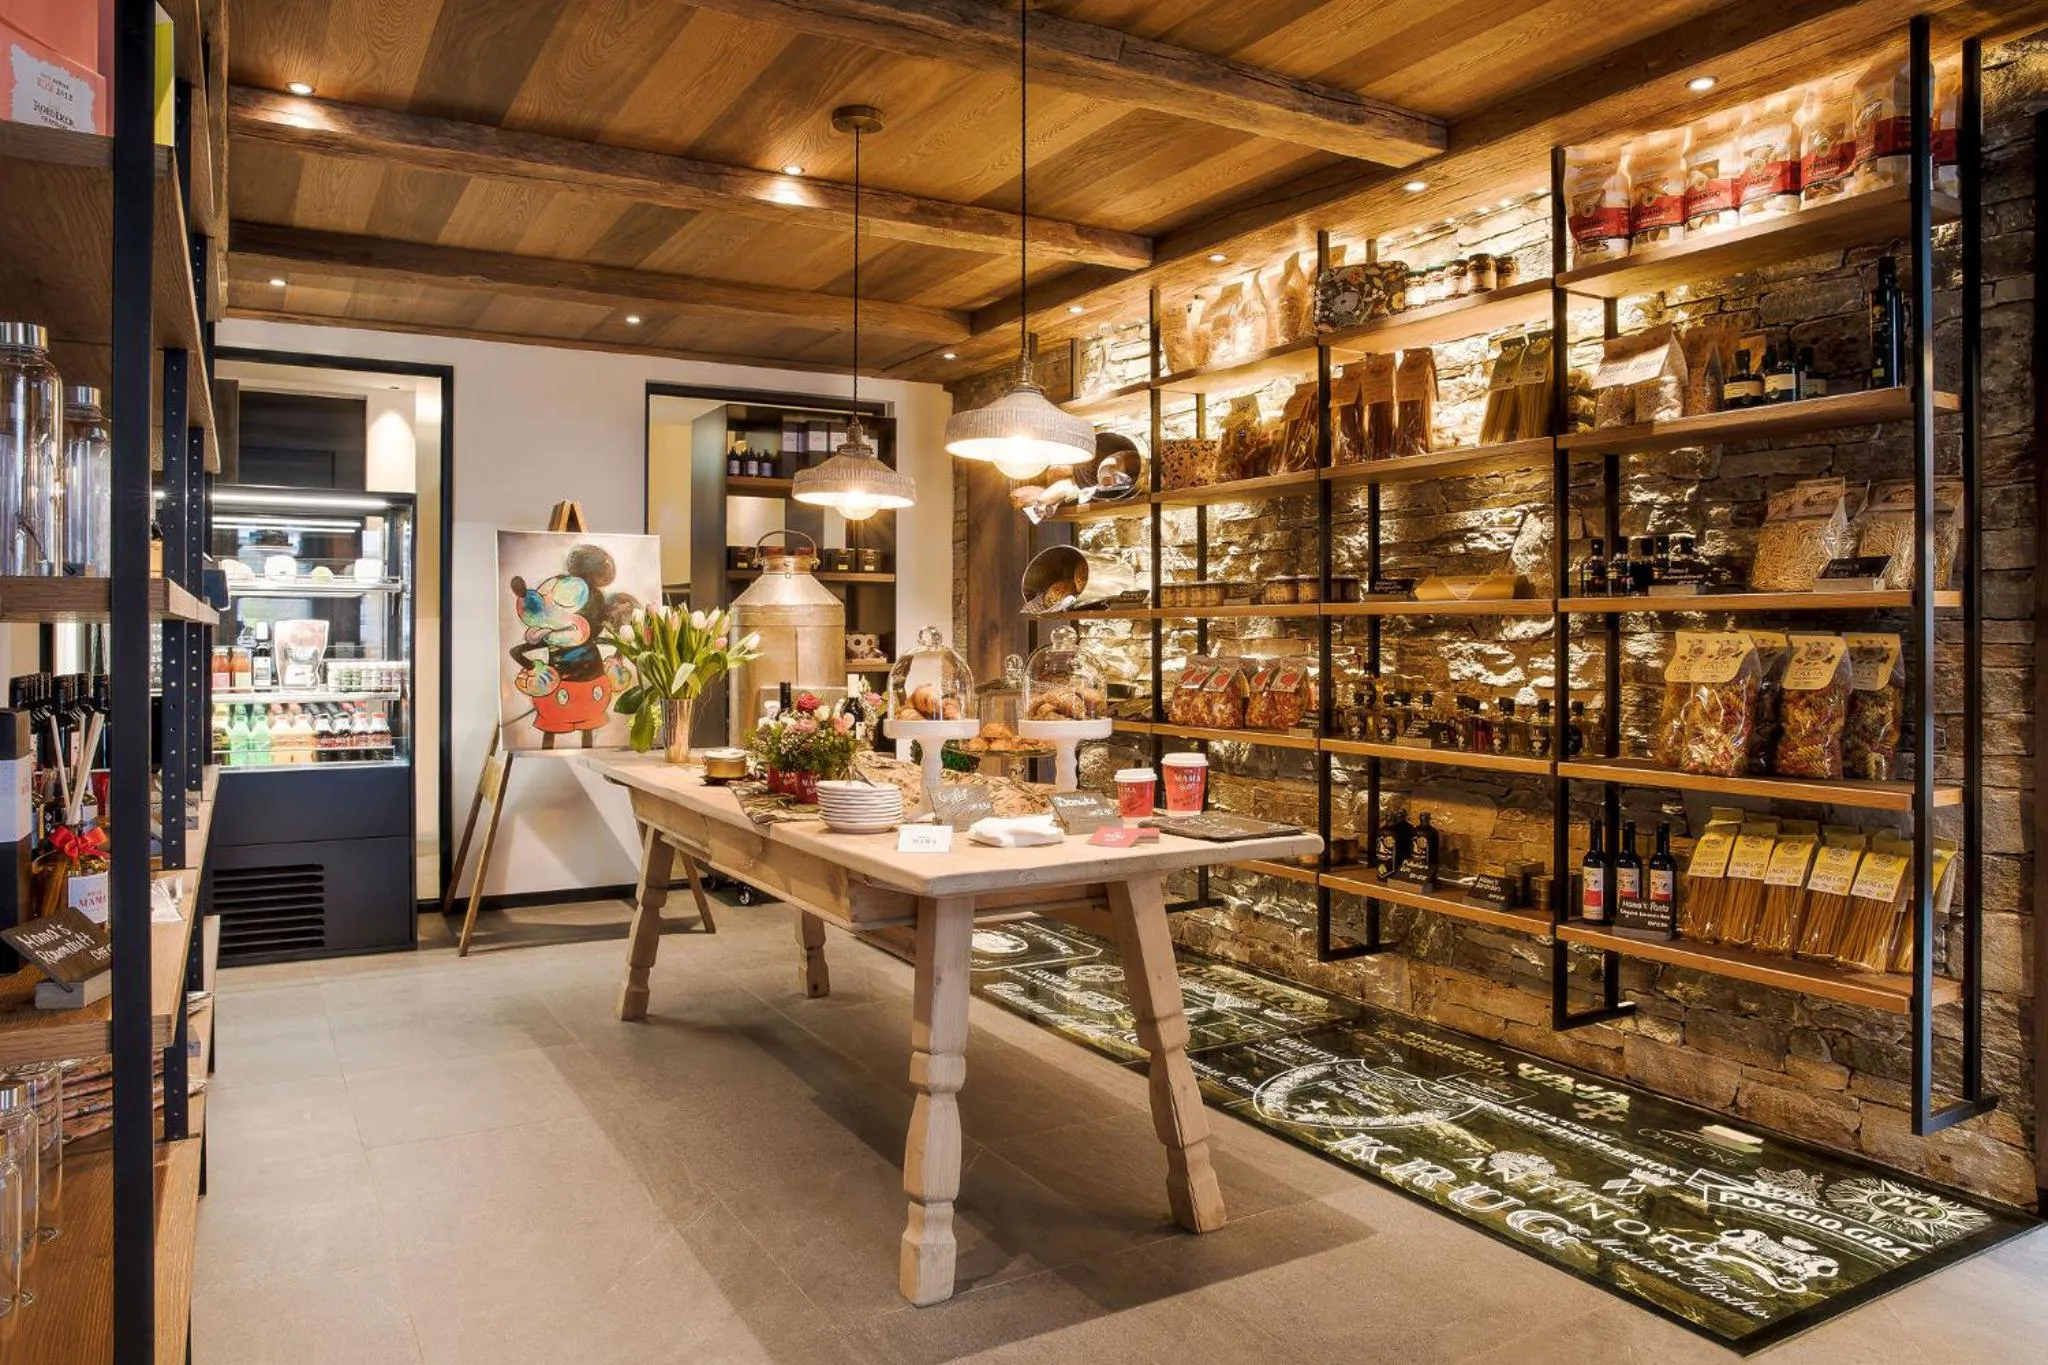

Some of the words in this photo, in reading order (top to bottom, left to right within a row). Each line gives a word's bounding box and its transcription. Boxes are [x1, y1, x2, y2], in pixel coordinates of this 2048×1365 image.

[1053, 796, 1098, 808] Donuts
[1638, 1128, 1691, 1151] OPUS
[1693, 1146, 1744, 1167] ONE
[1326, 1132, 1593, 1251] KRUG
[1878, 1194, 1932, 1221] PG
[1718, 1190, 1842, 1231] POGGIO
[1843, 1224, 1912, 1259] GRA
[1591, 1237, 1681, 1279] Mouton
[1678, 1273, 1770, 1320] Roths
